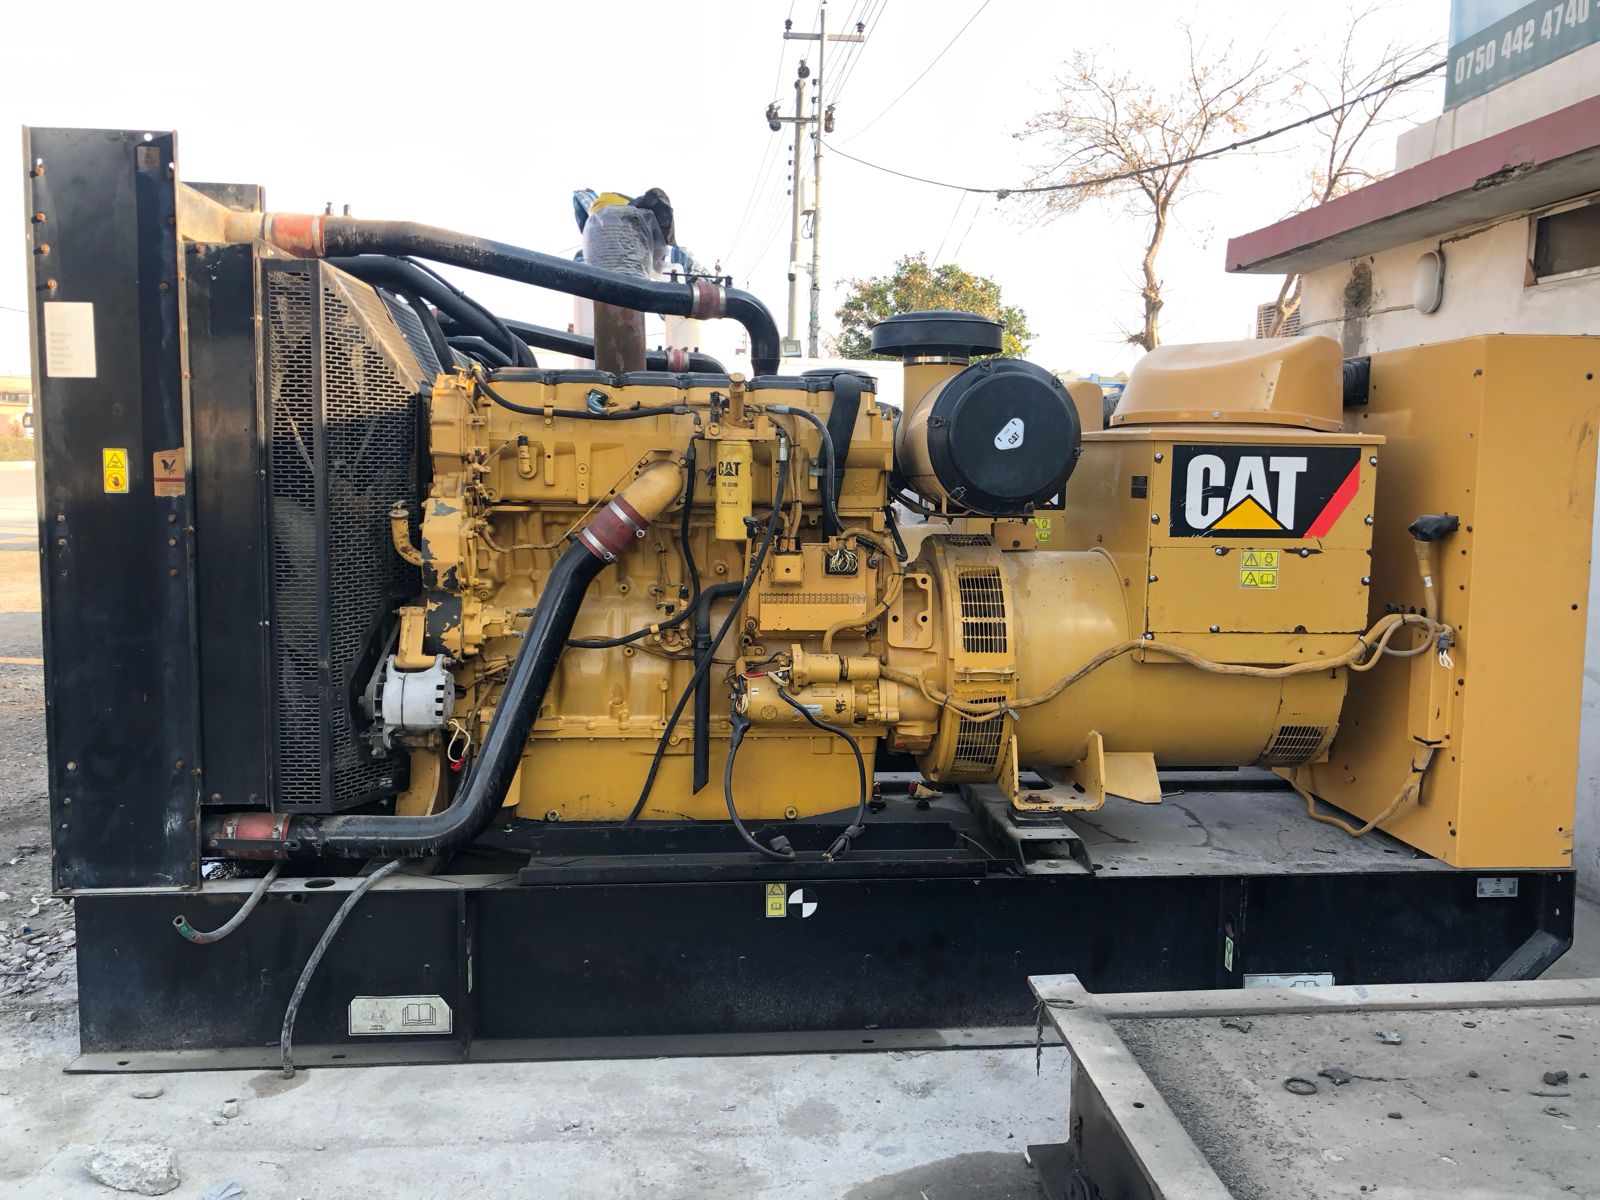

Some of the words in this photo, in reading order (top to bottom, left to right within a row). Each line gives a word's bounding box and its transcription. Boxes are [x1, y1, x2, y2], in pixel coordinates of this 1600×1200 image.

[1455, 39, 1496, 85] 0750
[1501, 18, 1535, 59] 442
[1540, 0, 1590, 40] 4740
[1007, 431, 1020, 445] CAT
[718, 461, 742, 477] CAT
[1185, 454, 1308, 530] CAT
